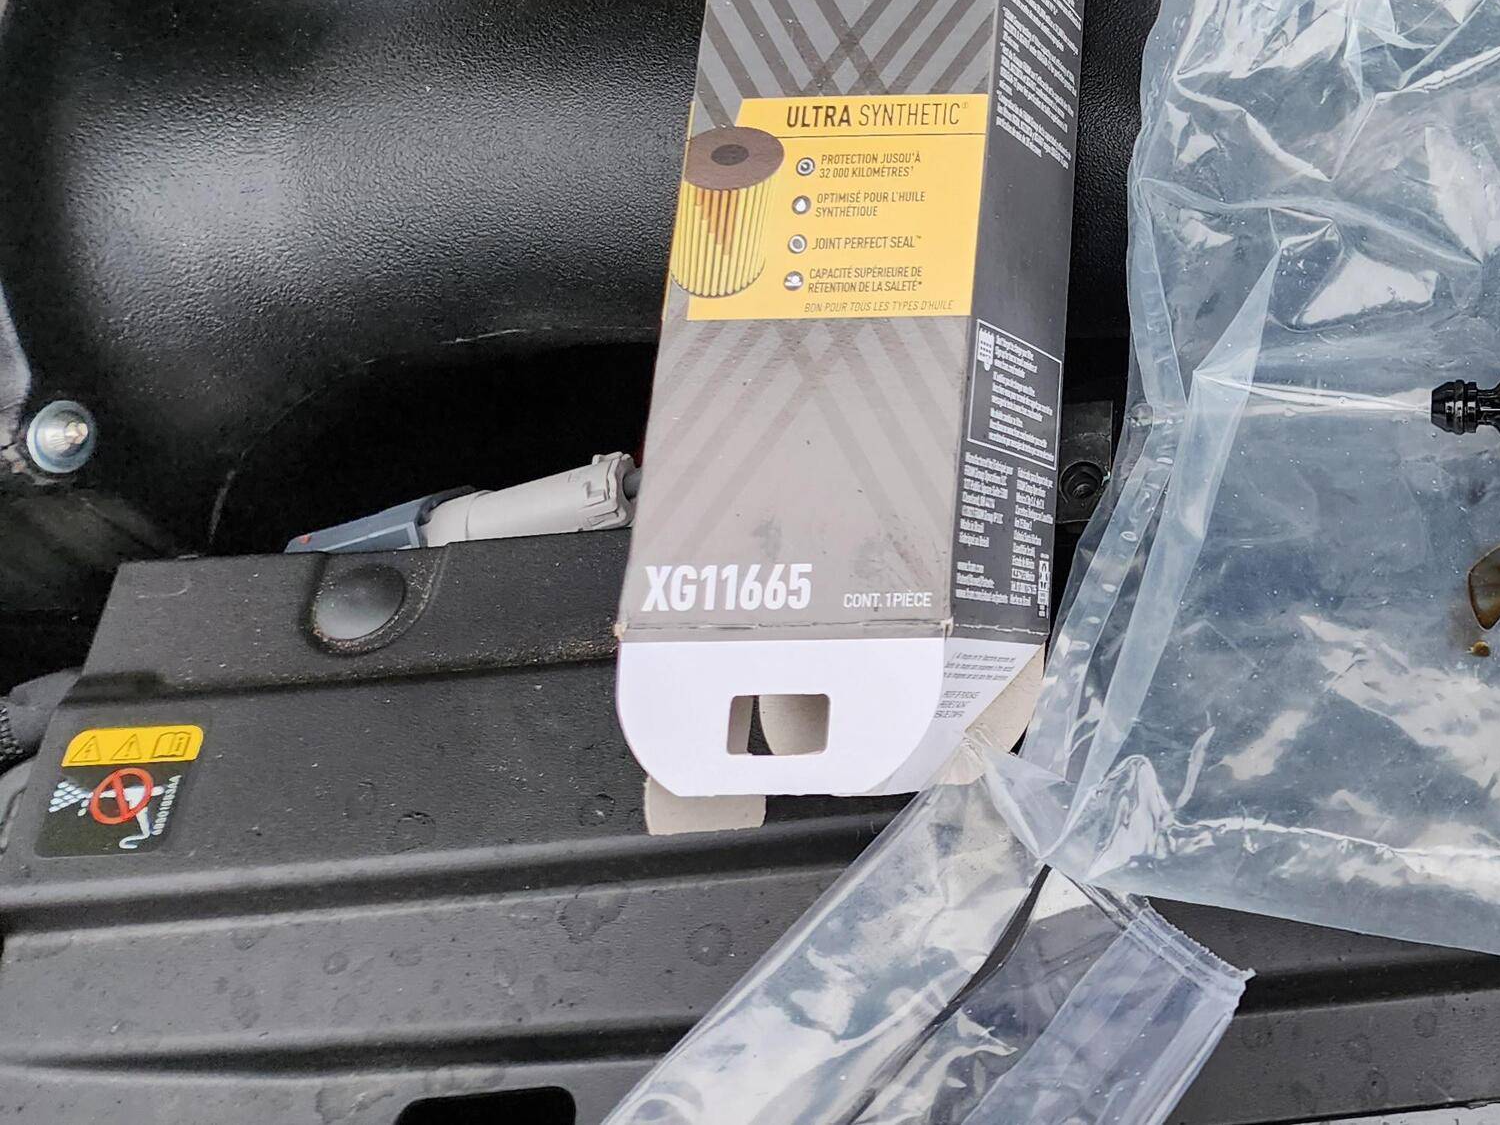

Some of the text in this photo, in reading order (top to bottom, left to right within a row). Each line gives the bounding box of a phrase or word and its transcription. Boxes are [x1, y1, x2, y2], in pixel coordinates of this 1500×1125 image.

[786, 105, 852, 127] ULTRA
[821, 153, 878, 165] PROTECTION
[819, 168, 831, 178] 32
[833, 167, 849, 178] 000
[817, 191, 926, 204] OPTIMISÉ POUR L'HUILE
[815, 205, 878, 218] SYNTHÉTIQUE
[812, 237, 843, 250] JOINT
[844, 236, 888, 249] PERFECT
[809, 265, 923, 279] CAPACITÉ SUPÉRIEURE DE
[808, 280, 857, 293] RÉTENTION
[858, 281, 870, 292] DE
[872, 281, 883, 292] LA
[804, 299, 954, 313] BON POUR TOUS LES TYPES D'HUILE
[641, 563, 812, 612] XG11665
[843, 592, 882, 608] CONT.
